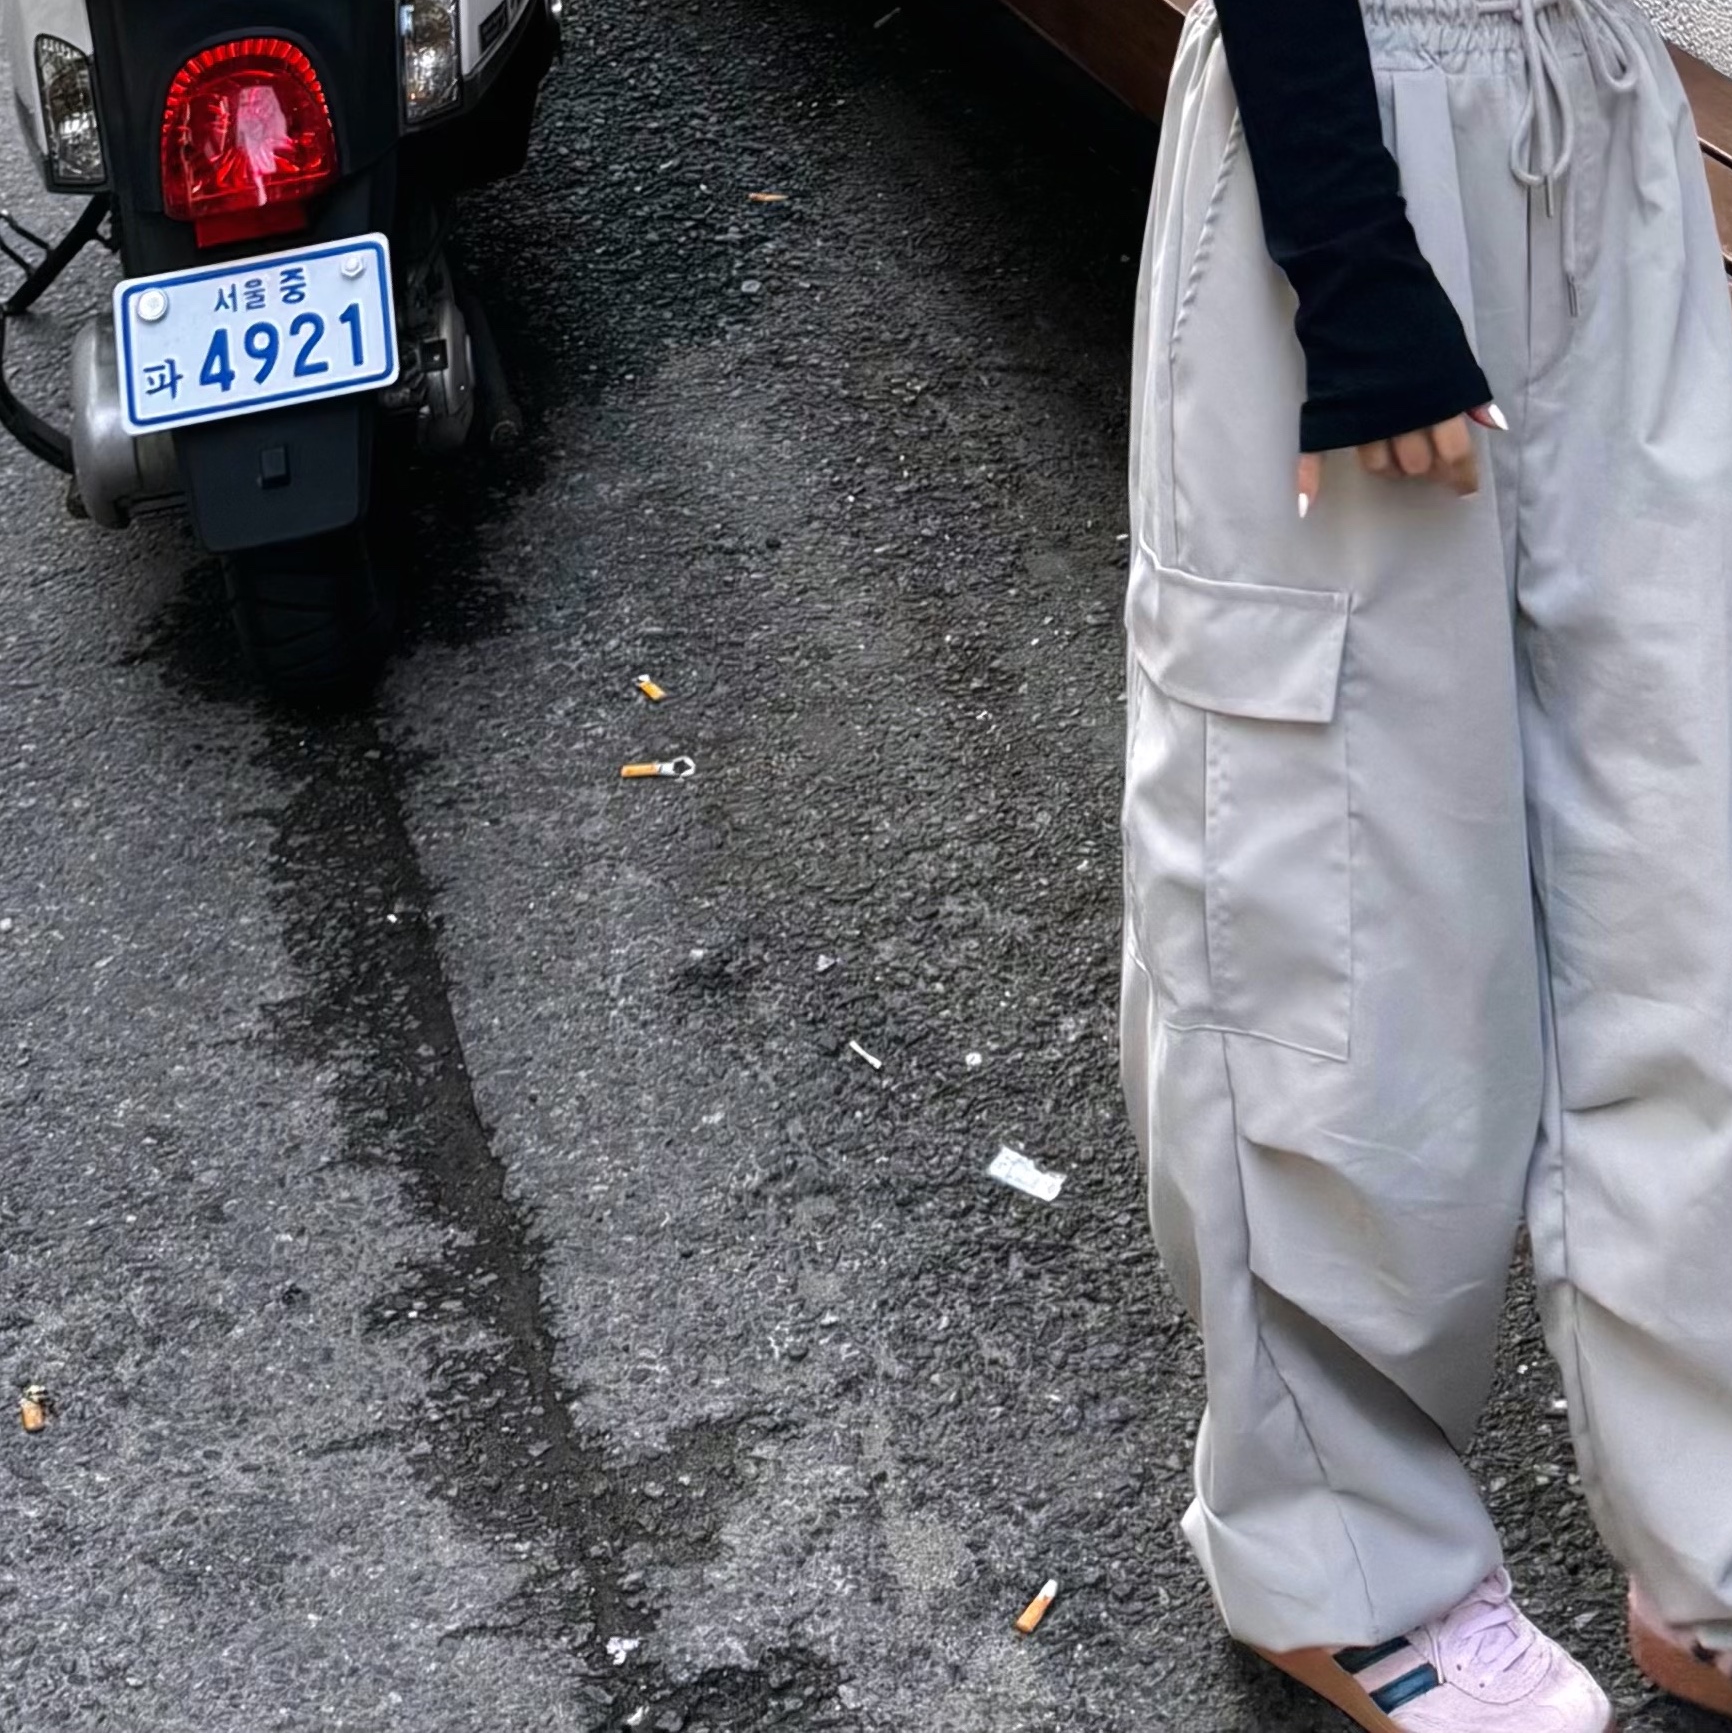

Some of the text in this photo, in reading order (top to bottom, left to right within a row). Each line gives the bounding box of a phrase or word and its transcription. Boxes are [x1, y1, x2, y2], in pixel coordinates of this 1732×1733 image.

[214, 267, 307, 313] 서울 중
[143, 302, 365, 400] 파 4921
